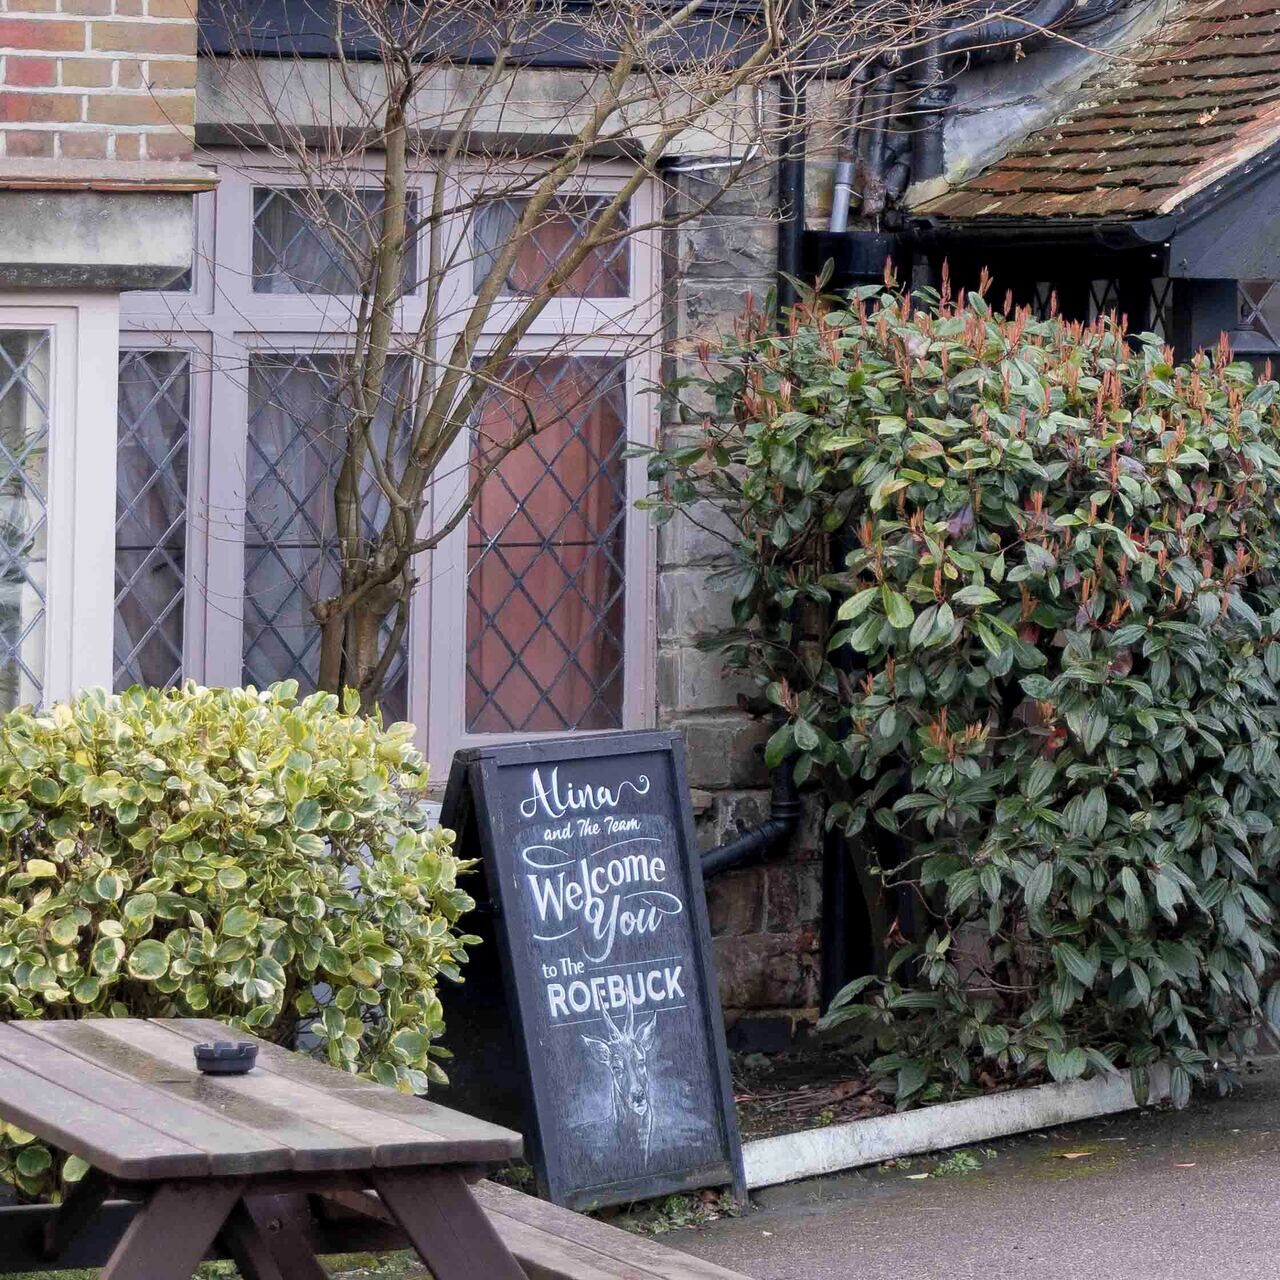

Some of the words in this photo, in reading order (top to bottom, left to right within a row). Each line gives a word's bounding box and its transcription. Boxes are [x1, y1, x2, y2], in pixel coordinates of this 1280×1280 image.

[520, 766, 650, 818] Alina
[544, 822, 575, 841] and
[577, 817, 601, 837] The
[604, 816, 641, 835] Team
[526, 854, 666, 921] Welcome
[582, 894, 664, 963] You
[541, 963, 558, 979] to
[560, 957, 585, 977] The
[546, 965, 686, 1018] ROEBUCK
